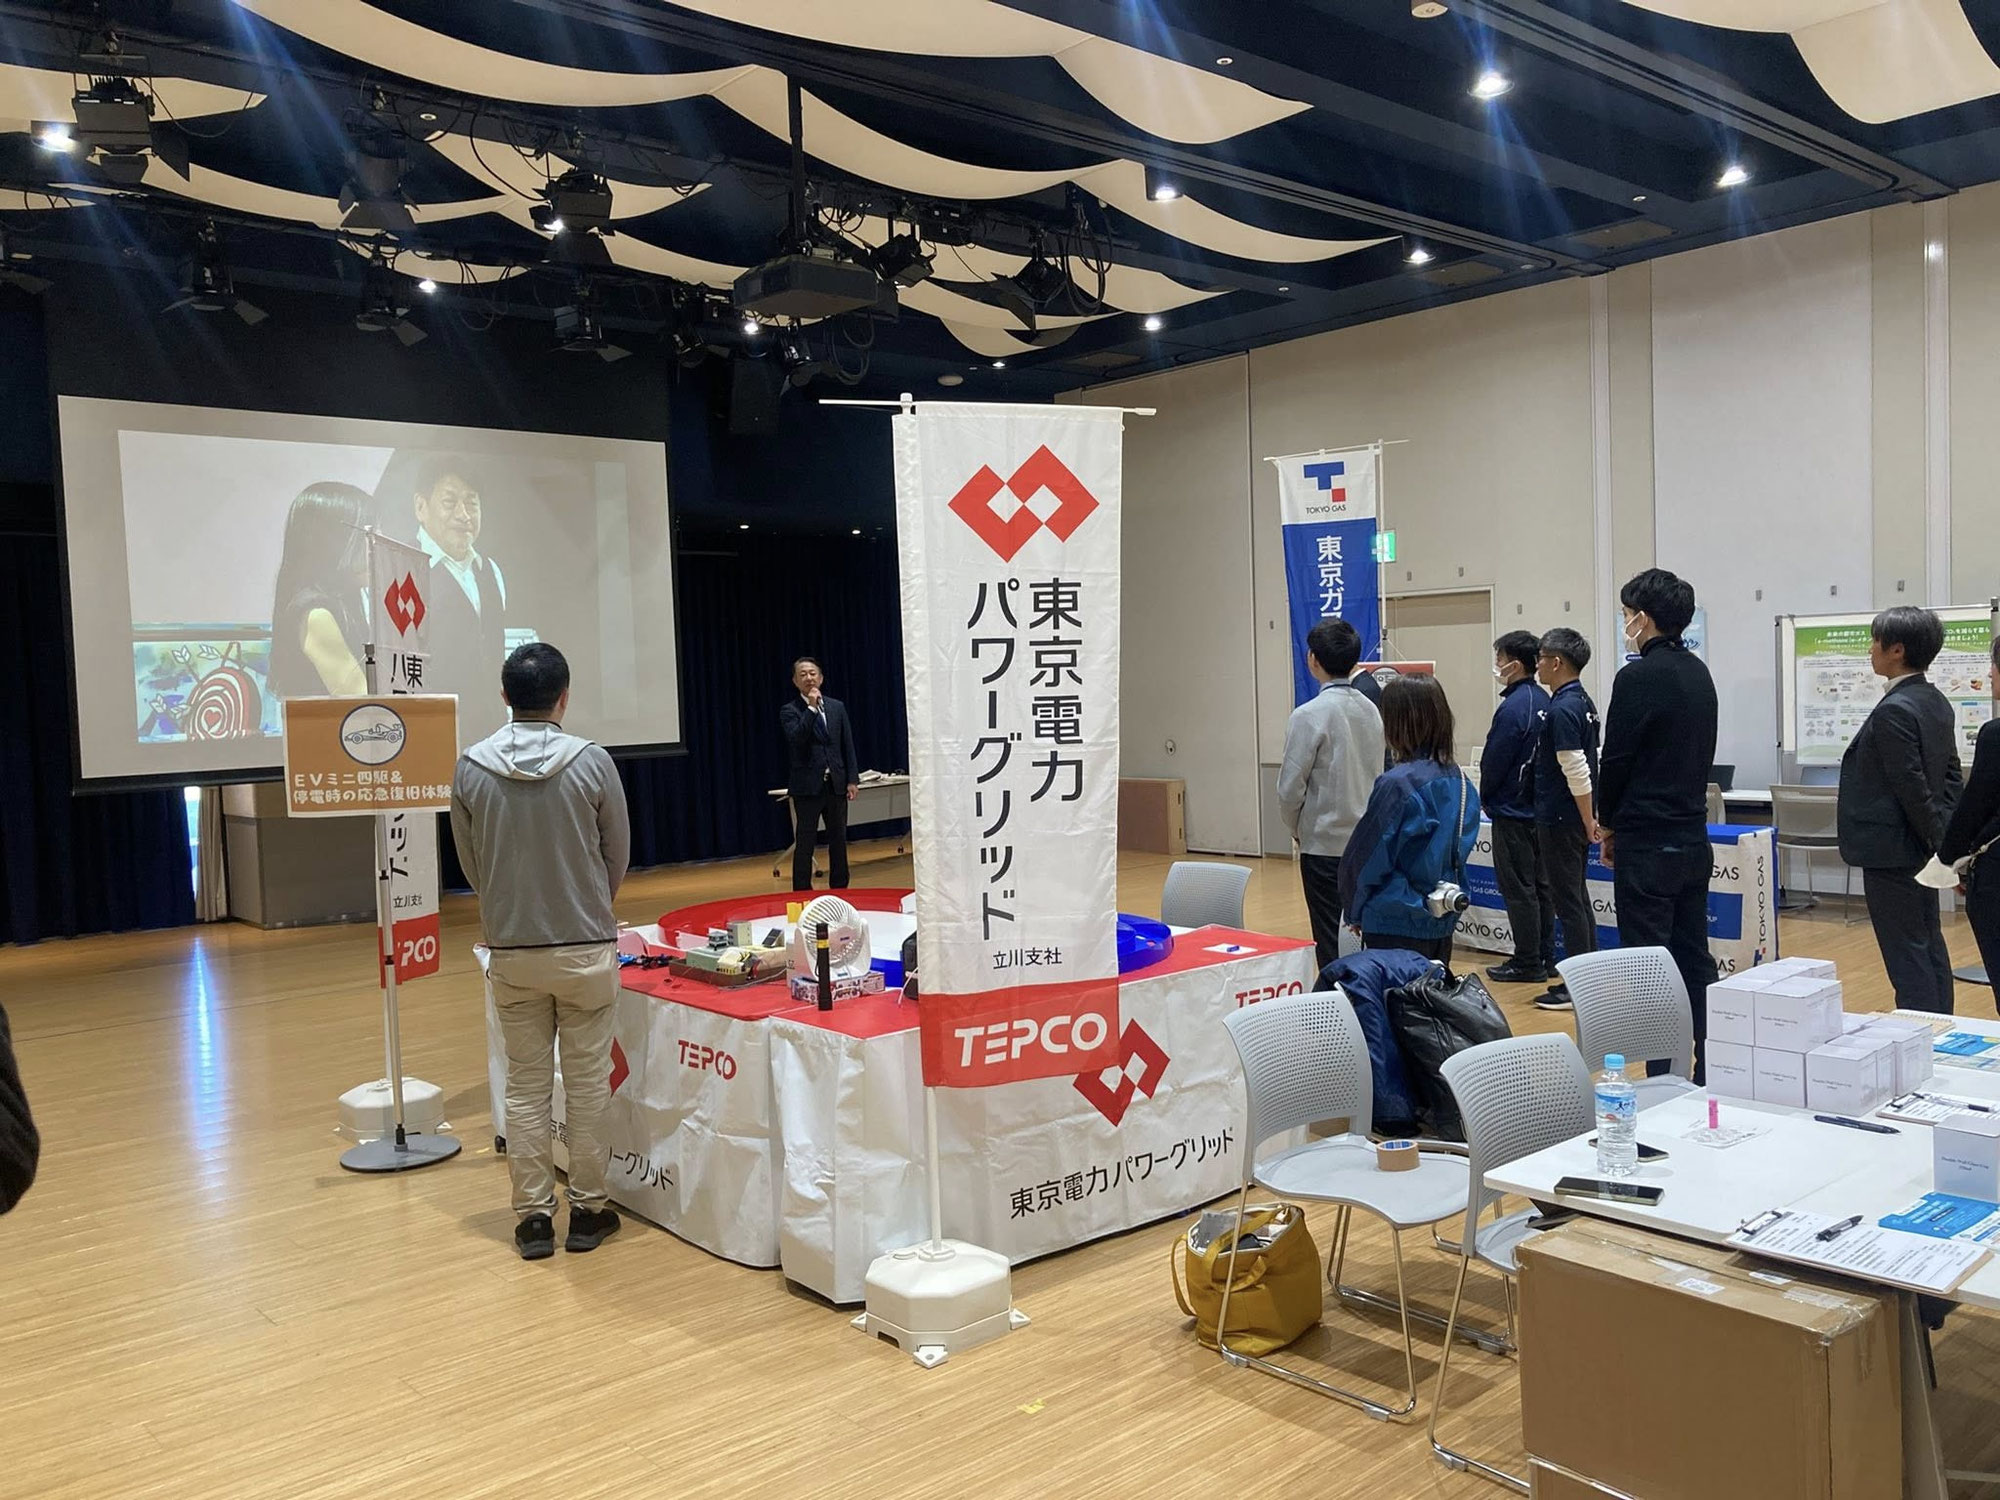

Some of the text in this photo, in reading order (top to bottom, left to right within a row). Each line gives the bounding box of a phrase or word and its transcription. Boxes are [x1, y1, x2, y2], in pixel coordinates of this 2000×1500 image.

[1305, 503, 1347, 515] TOKYO GAS
[1029, 577, 1084, 802] 東京電力
[967, 577, 1022, 941] パワーグリッド
[1711, 864, 1740, 881] GAS
[1756, 855, 1767, 945] TOKYO GAS
[397, 935, 436, 967] PCO
[1454, 920, 1514, 942] OKYO GA
[992, 947, 1063, 970] 立川支社
[1718, 958, 1736, 973] AS
[678, 1039, 737, 1080] TEPCO
[953, 1012, 1109, 1068] TEPCO
[608, 1146, 674, 1191] ーグリッド
[1009, 1126, 1234, 1220] 東京電力パワーグリッド
